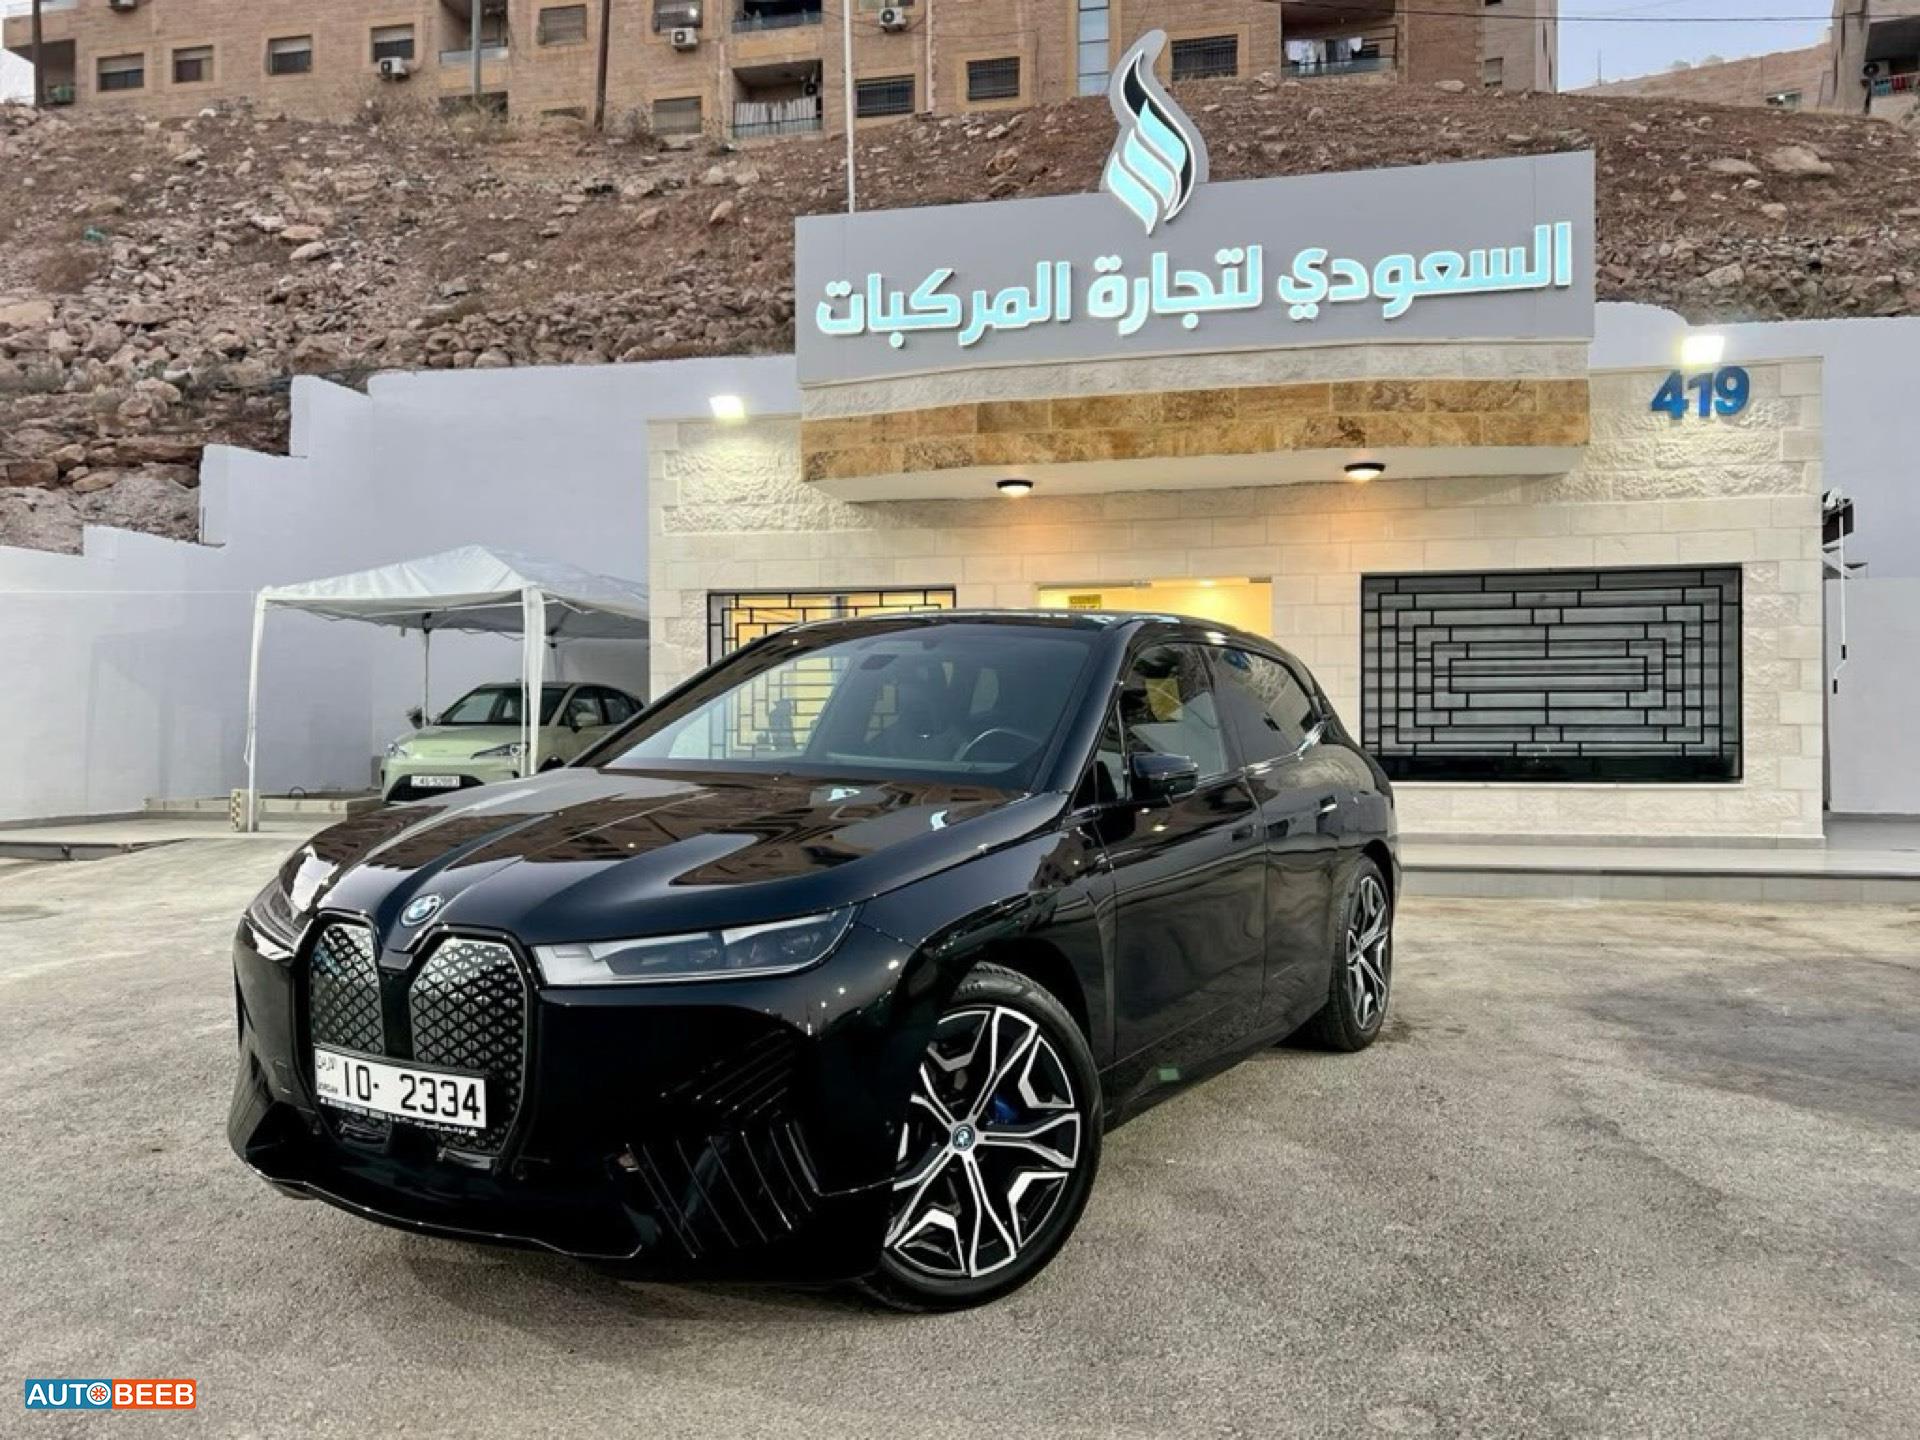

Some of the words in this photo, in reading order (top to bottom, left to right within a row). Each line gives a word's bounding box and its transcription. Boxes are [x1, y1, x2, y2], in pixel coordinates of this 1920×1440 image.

[815, 261, 1072, 348] المركبات
[1087, 244, 1263, 336] لتجارة
[1278, 221, 1572, 321] السعودي
[1651, 366, 1750, 420] 419
